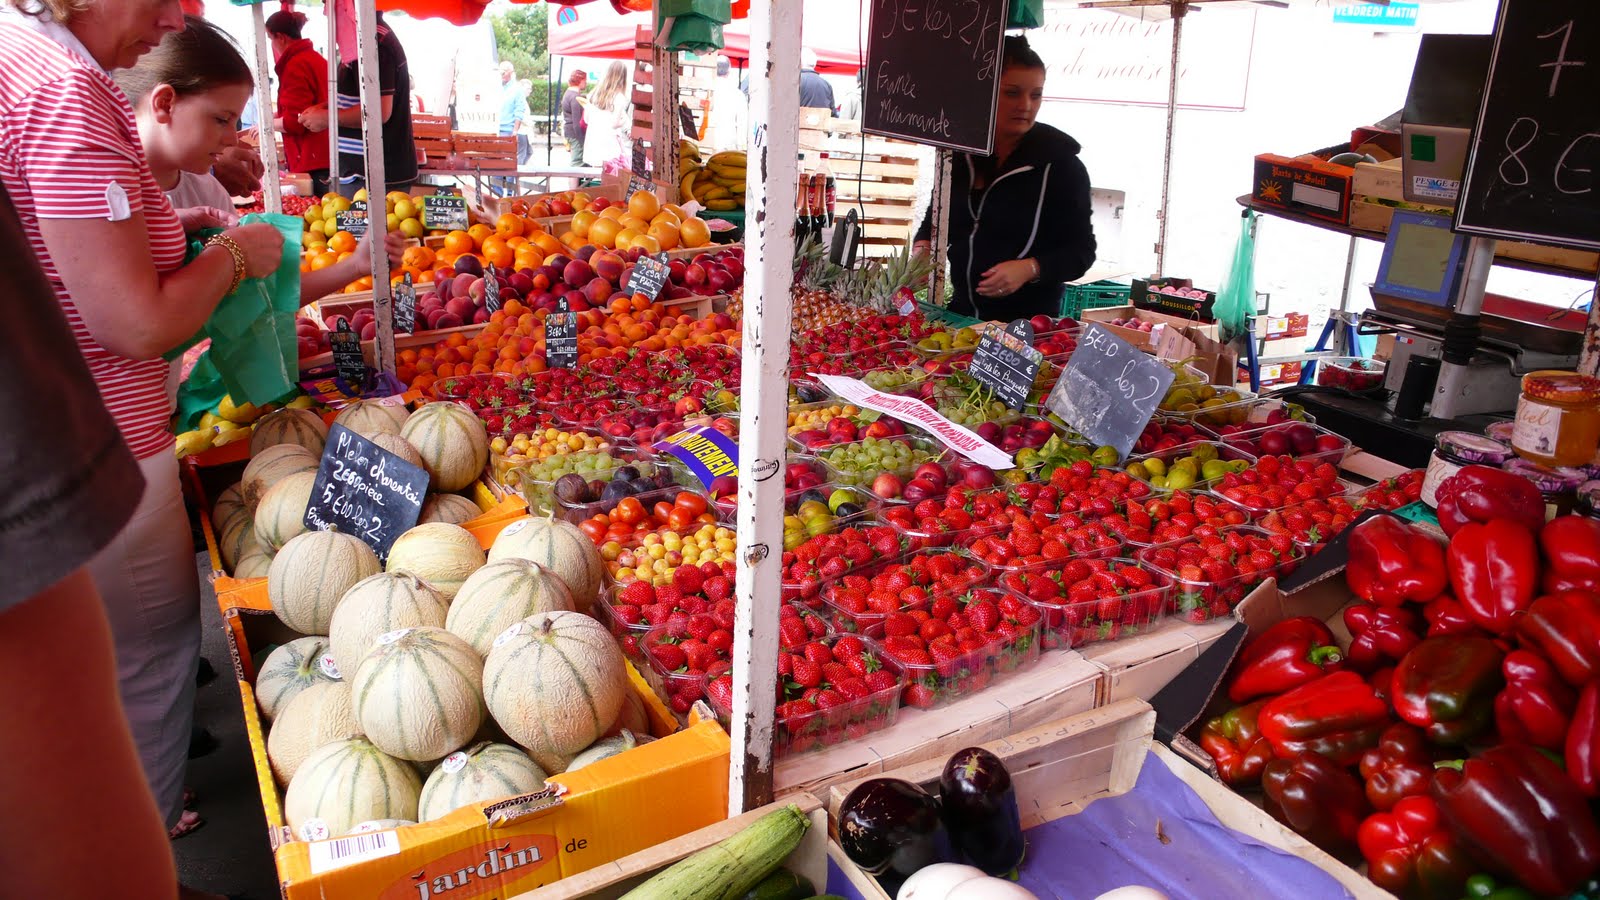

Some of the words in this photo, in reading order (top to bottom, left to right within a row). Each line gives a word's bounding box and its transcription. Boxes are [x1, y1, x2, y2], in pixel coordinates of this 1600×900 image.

[1335, 5, 1383, 17] VENDREDI
[1385, 7, 1418, 19] MATIN
[1415, 177, 1449, 187] PESAGE
[1161, 300, 1196, 311] ROUSSILLON
[1025, 365, 1034, 375] €
[1114, 359, 1136, 400] les
[1132, 375, 1160, 417] 2
[335, 431, 369, 470] Melon
[370, 456, 421, 507] charentais
[351, 504, 369, 530] les
[366, 516, 383, 543] 2
[564, 838, 589, 854] de
[414, 841, 544, 900] jardin
